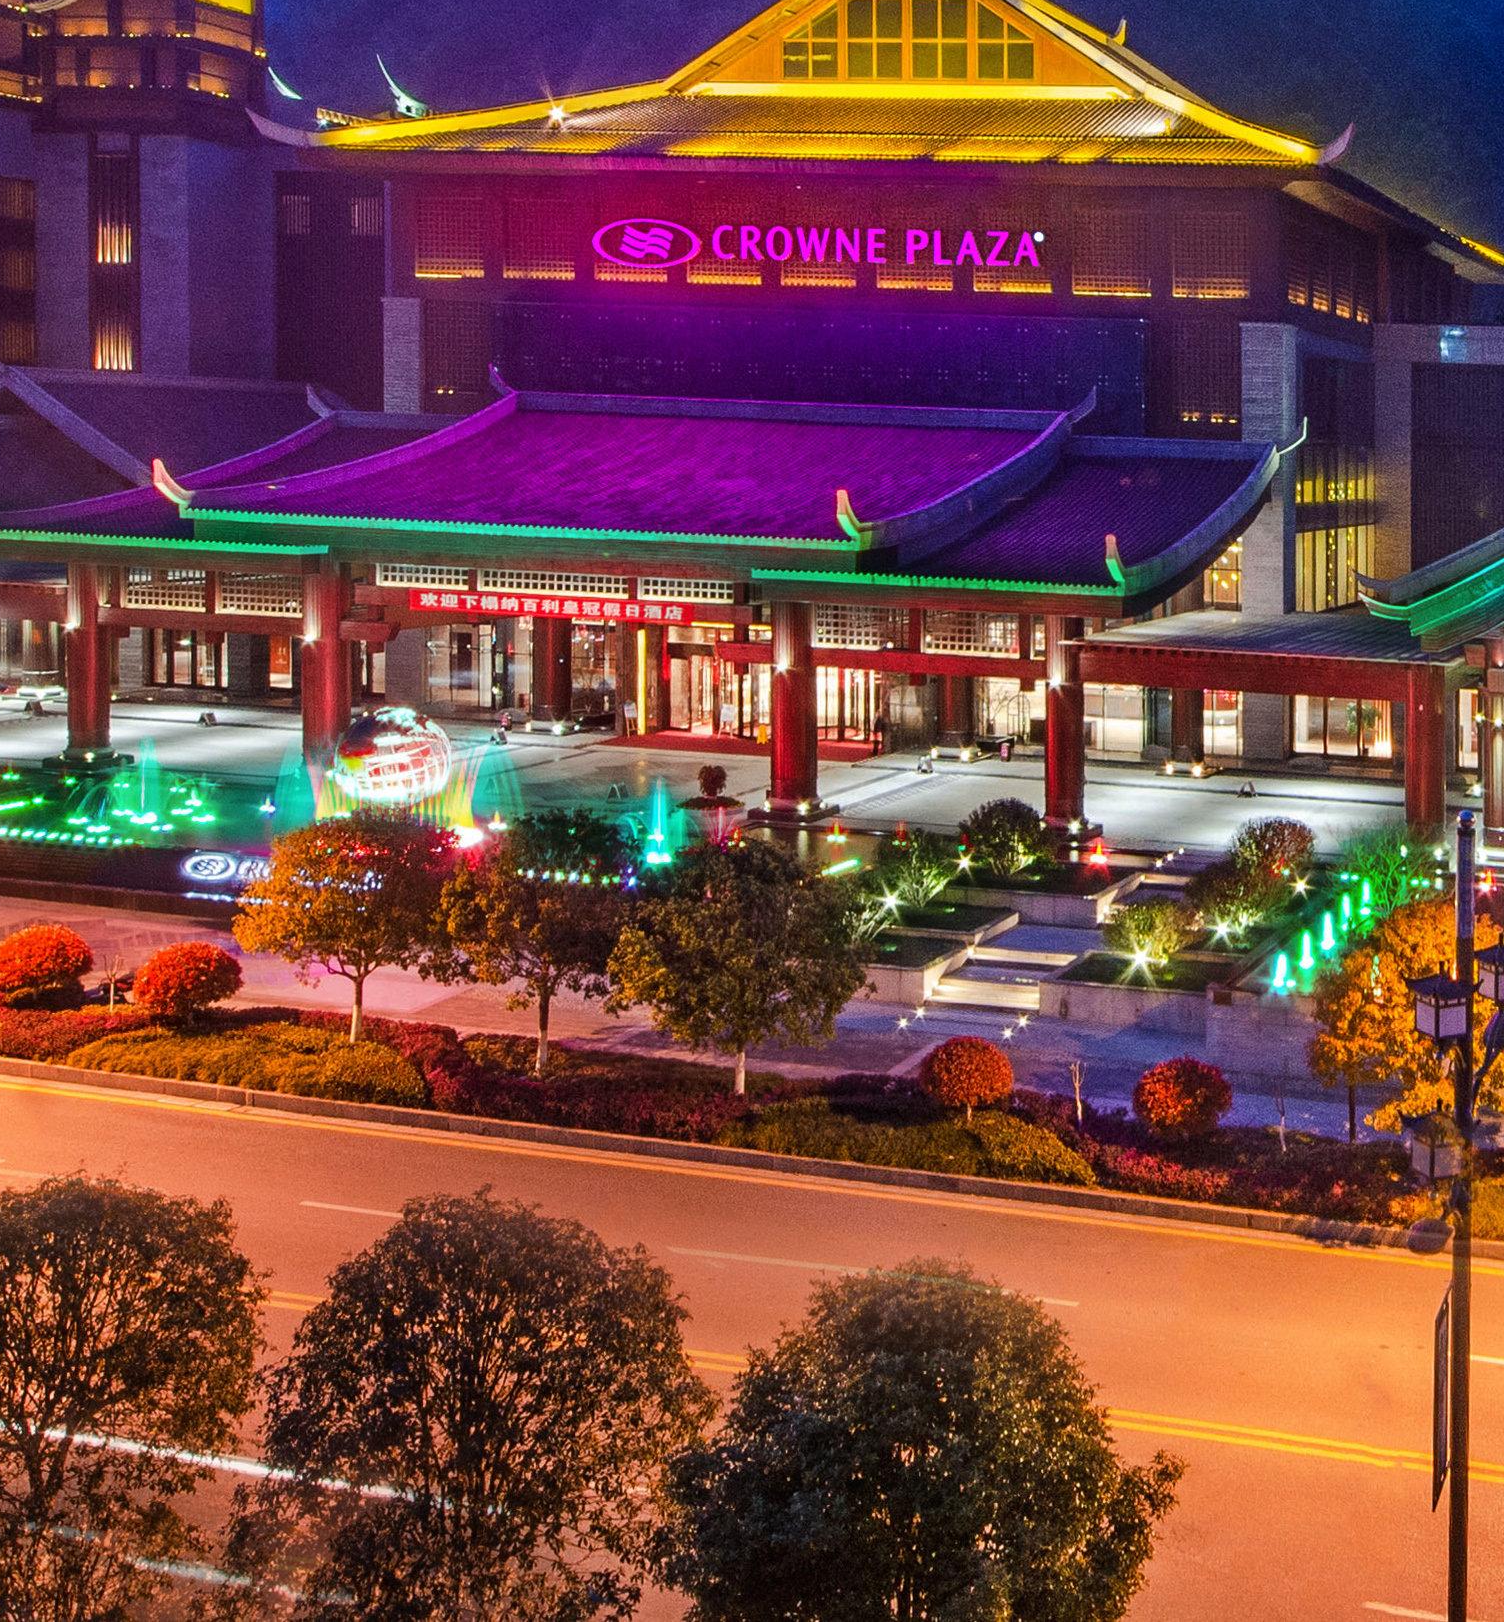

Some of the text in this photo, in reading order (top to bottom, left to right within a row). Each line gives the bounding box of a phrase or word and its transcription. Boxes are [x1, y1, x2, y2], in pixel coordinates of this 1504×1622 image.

[711, 224, 1040, 267] CROWNE PLAZA
[419, 592, 684, 622] 欢迎下榻纳百利皇冠假日酒店
